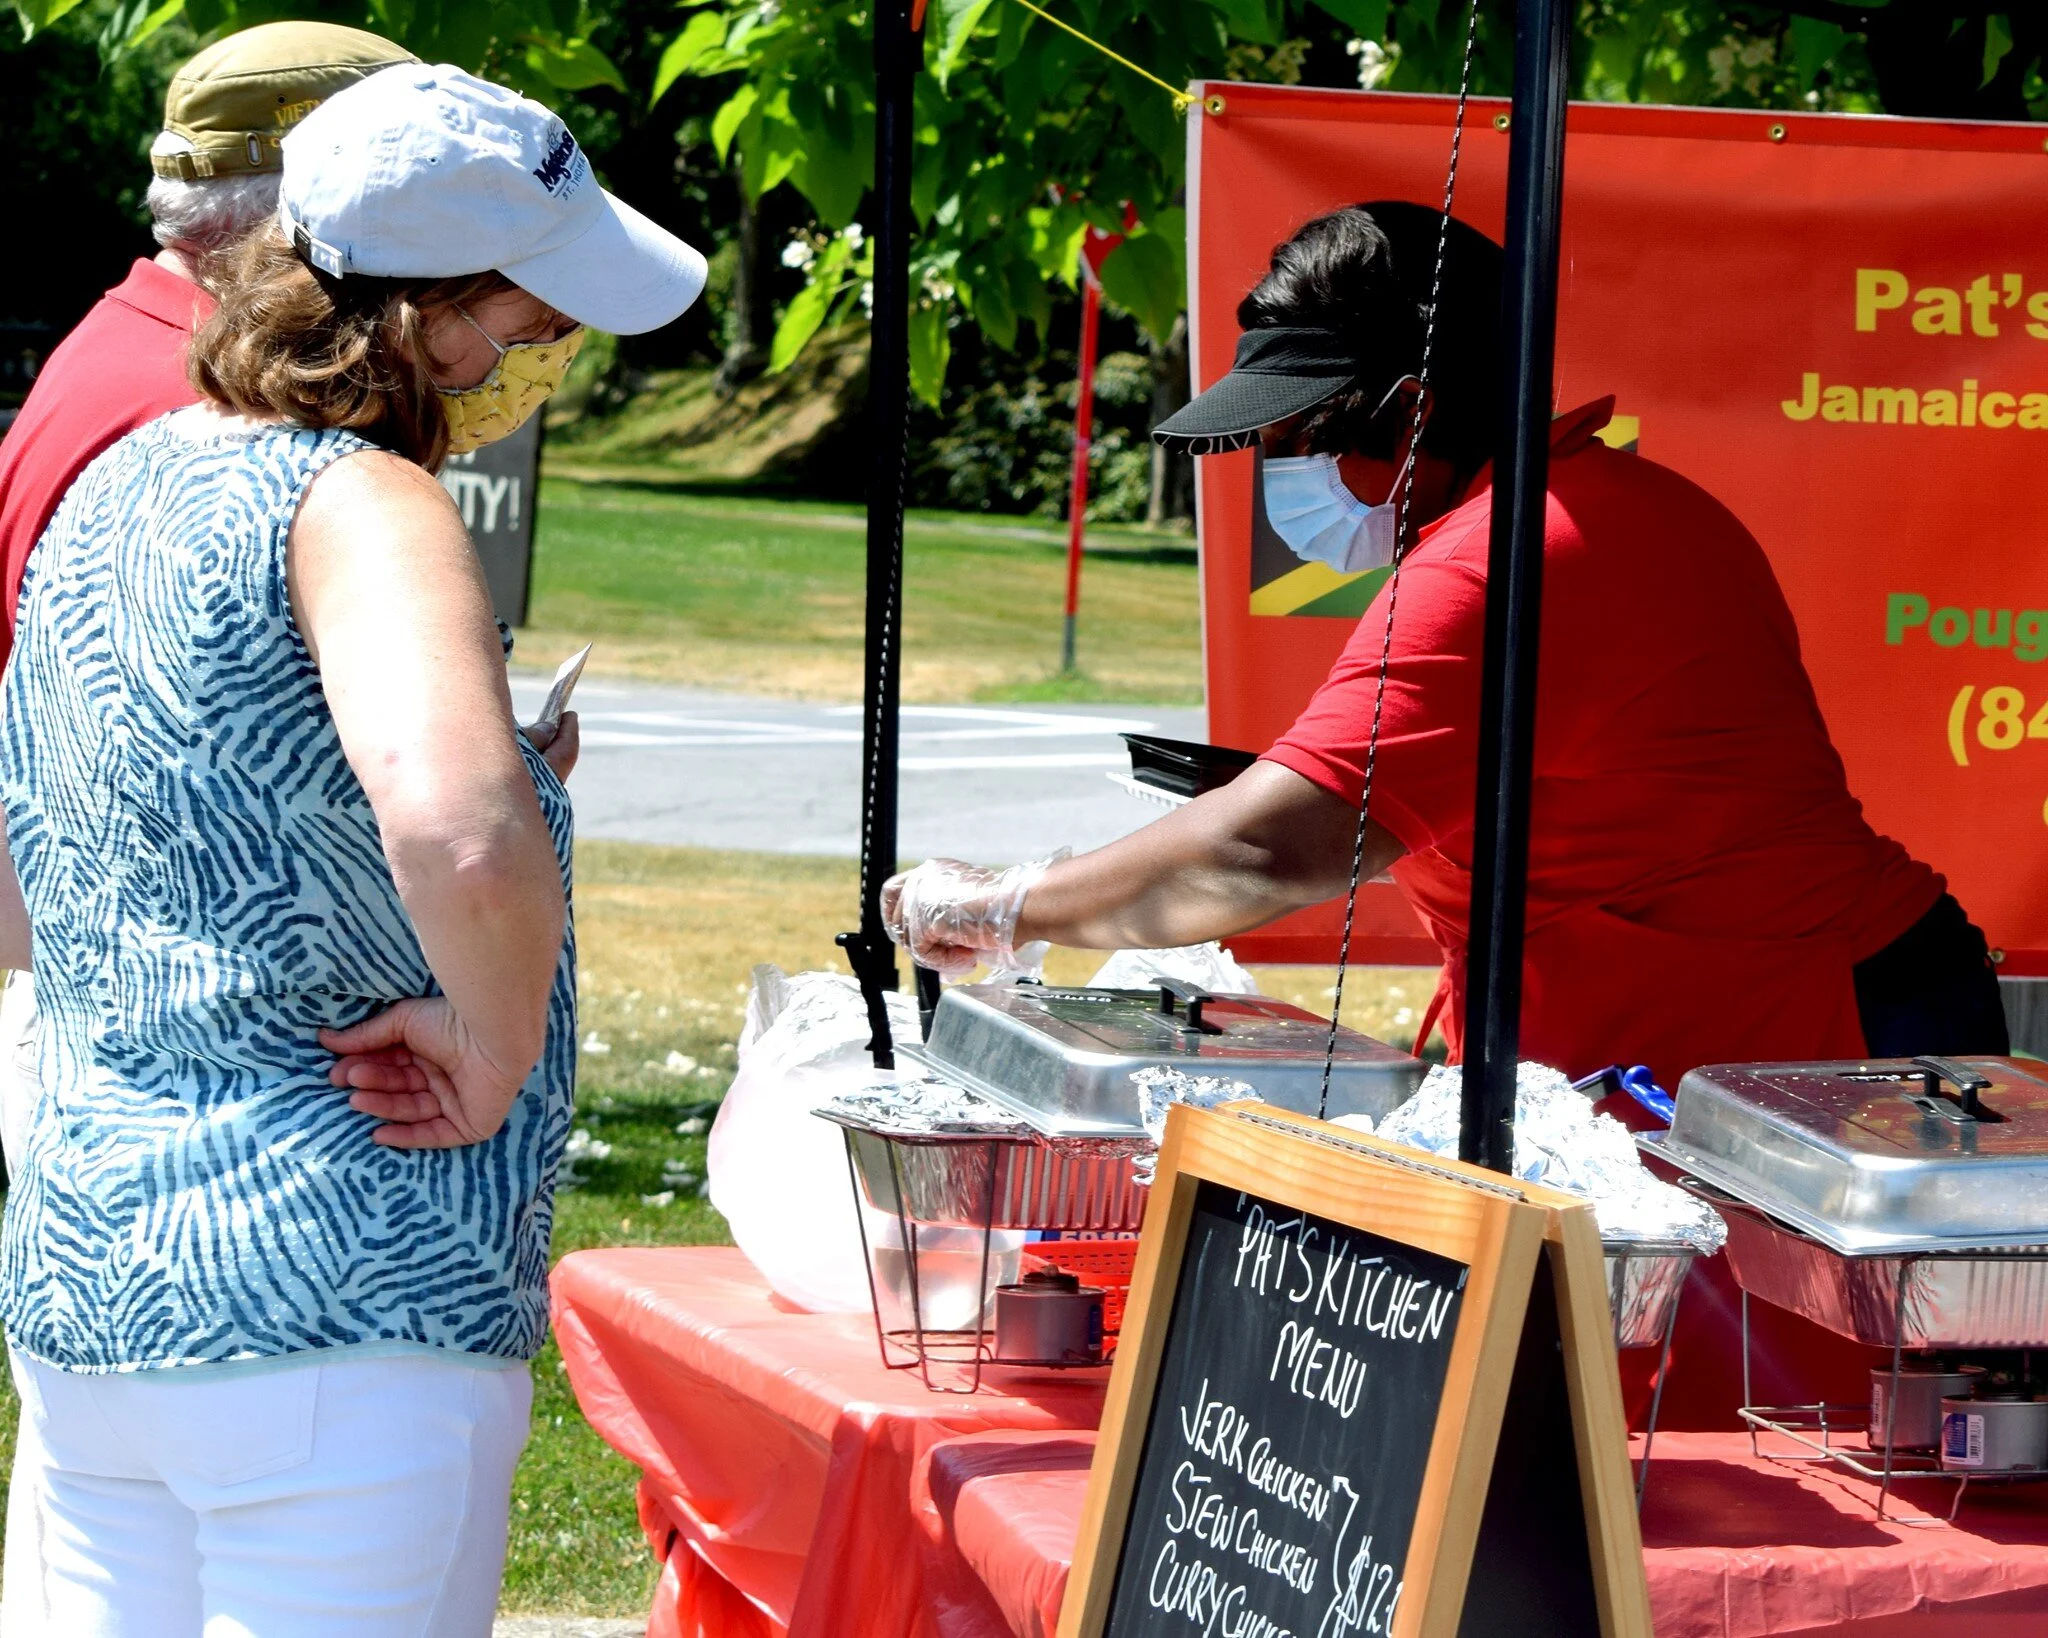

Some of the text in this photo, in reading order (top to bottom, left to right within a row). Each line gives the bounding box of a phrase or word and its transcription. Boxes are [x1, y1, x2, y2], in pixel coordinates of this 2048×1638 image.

[1855, 268, 2048, 340] Pat's
[1781, 372, 2048, 430] Jamaica
[1885, 592, 2048, 663] Poug
[1270, 1320, 1367, 1418] MENU
[1180, 1378, 1329, 1522] JERK CHICKEN
[1166, 1461, 1318, 1594] STEW CHICKEN
[1149, 1539, 1228, 1638] CURRY
